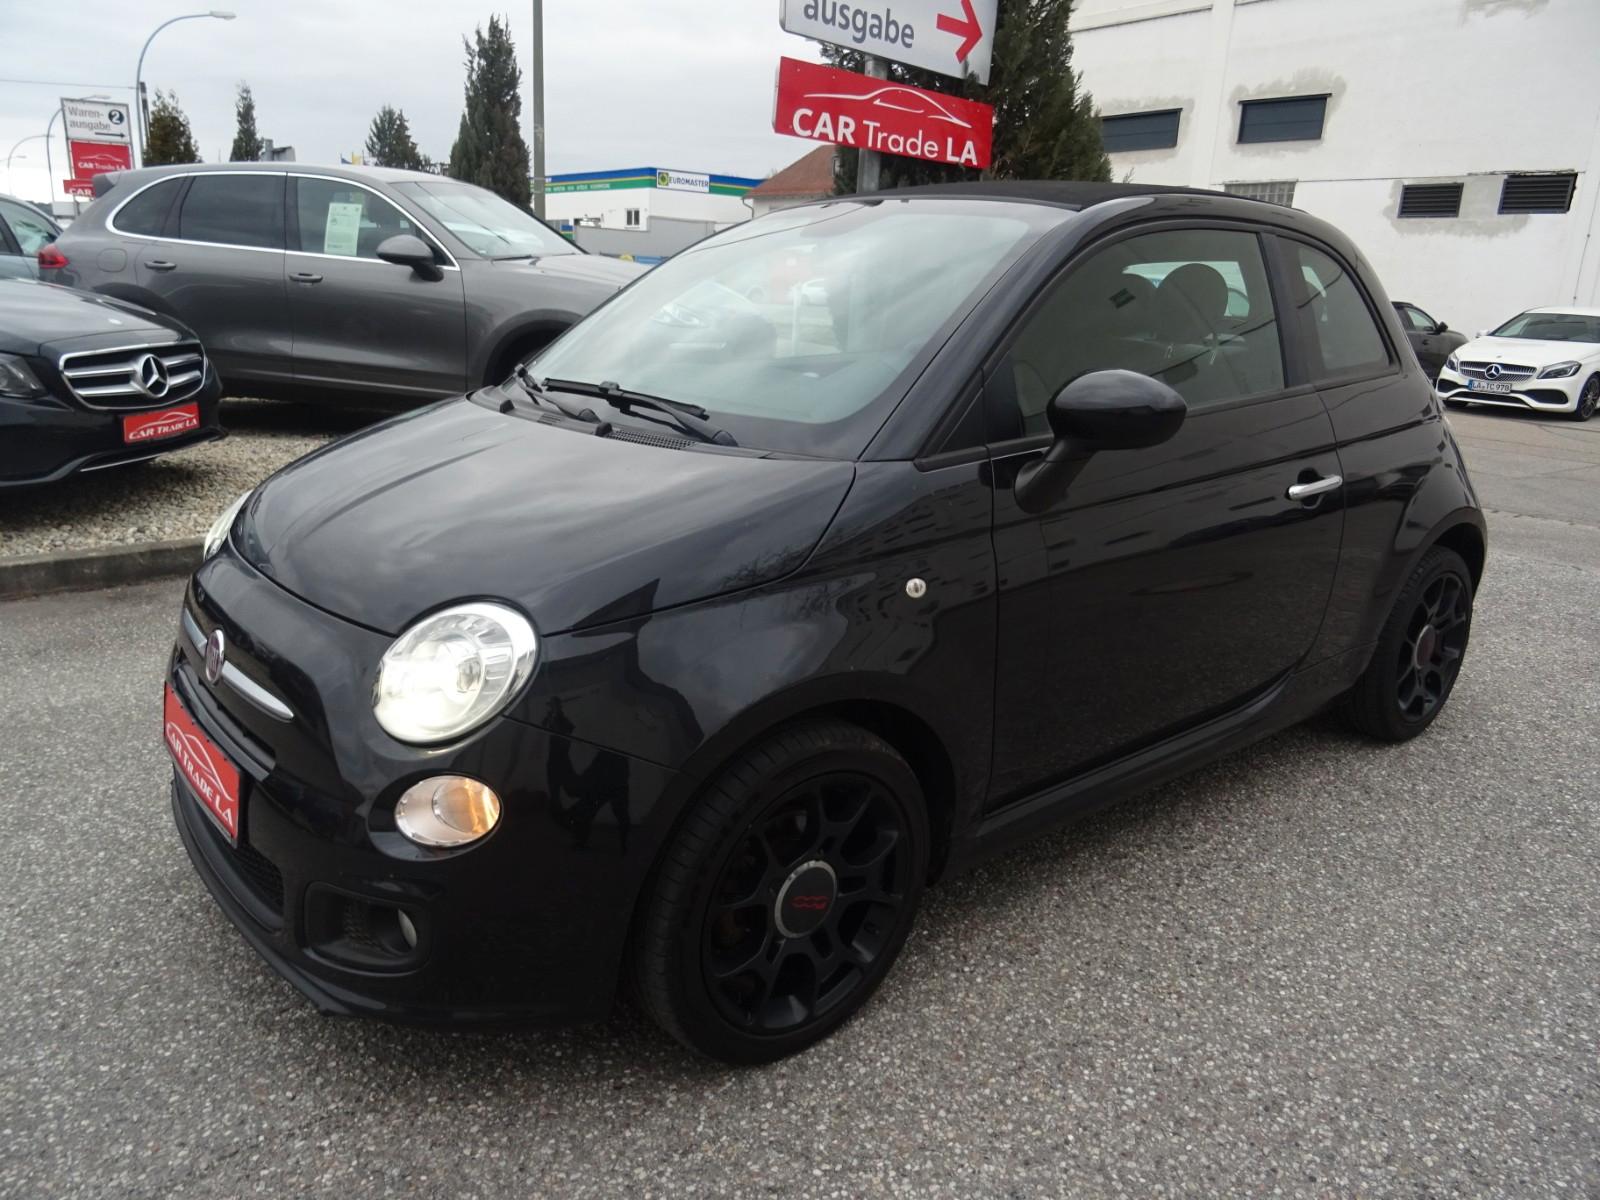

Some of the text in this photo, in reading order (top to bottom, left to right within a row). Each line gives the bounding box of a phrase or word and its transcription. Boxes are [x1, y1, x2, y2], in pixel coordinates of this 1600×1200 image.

[803, 0, 915, 48] ausgabe
[67, 106, 104, 117] Waren-
[69, 120, 111, 131] ausgabe
[792, 108, 978, 166] CAR Trade LA
[668, 176, 709, 188] EUROMASTER
[69, 188, 92, 196] CAR
[129, 429, 154, 440] CAR
[185, 418, 197, 427] LA
[166, 723, 233, 828] CAR TRADE LA
